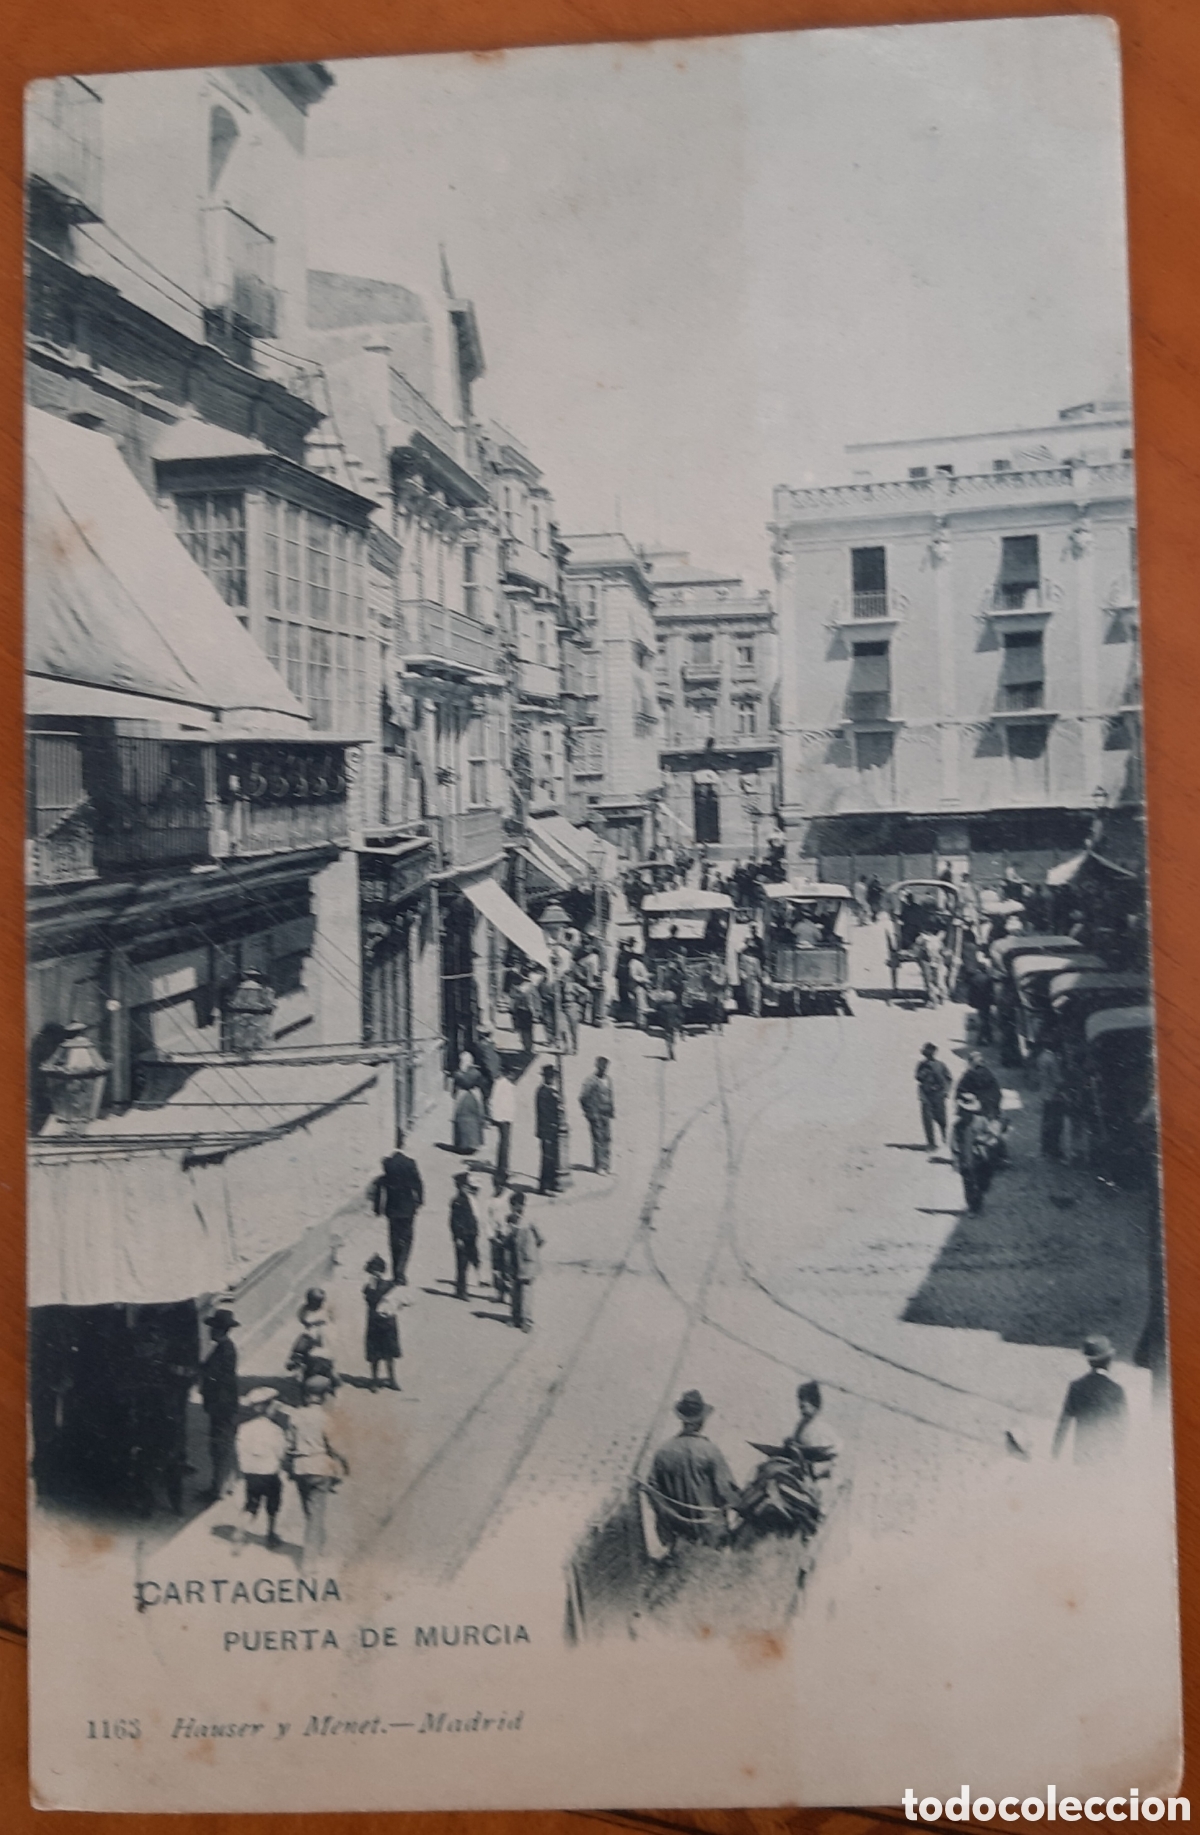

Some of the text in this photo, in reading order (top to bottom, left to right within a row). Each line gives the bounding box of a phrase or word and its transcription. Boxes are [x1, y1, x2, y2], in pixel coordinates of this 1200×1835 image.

[139, 1578, 341, 1606] CARTAGENA
[224, 1624, 531, 1652] PUERTA DE MURCIA
[171, 1717, 264, 1739] Hauser
[273, 1722, 292, 1740] y
